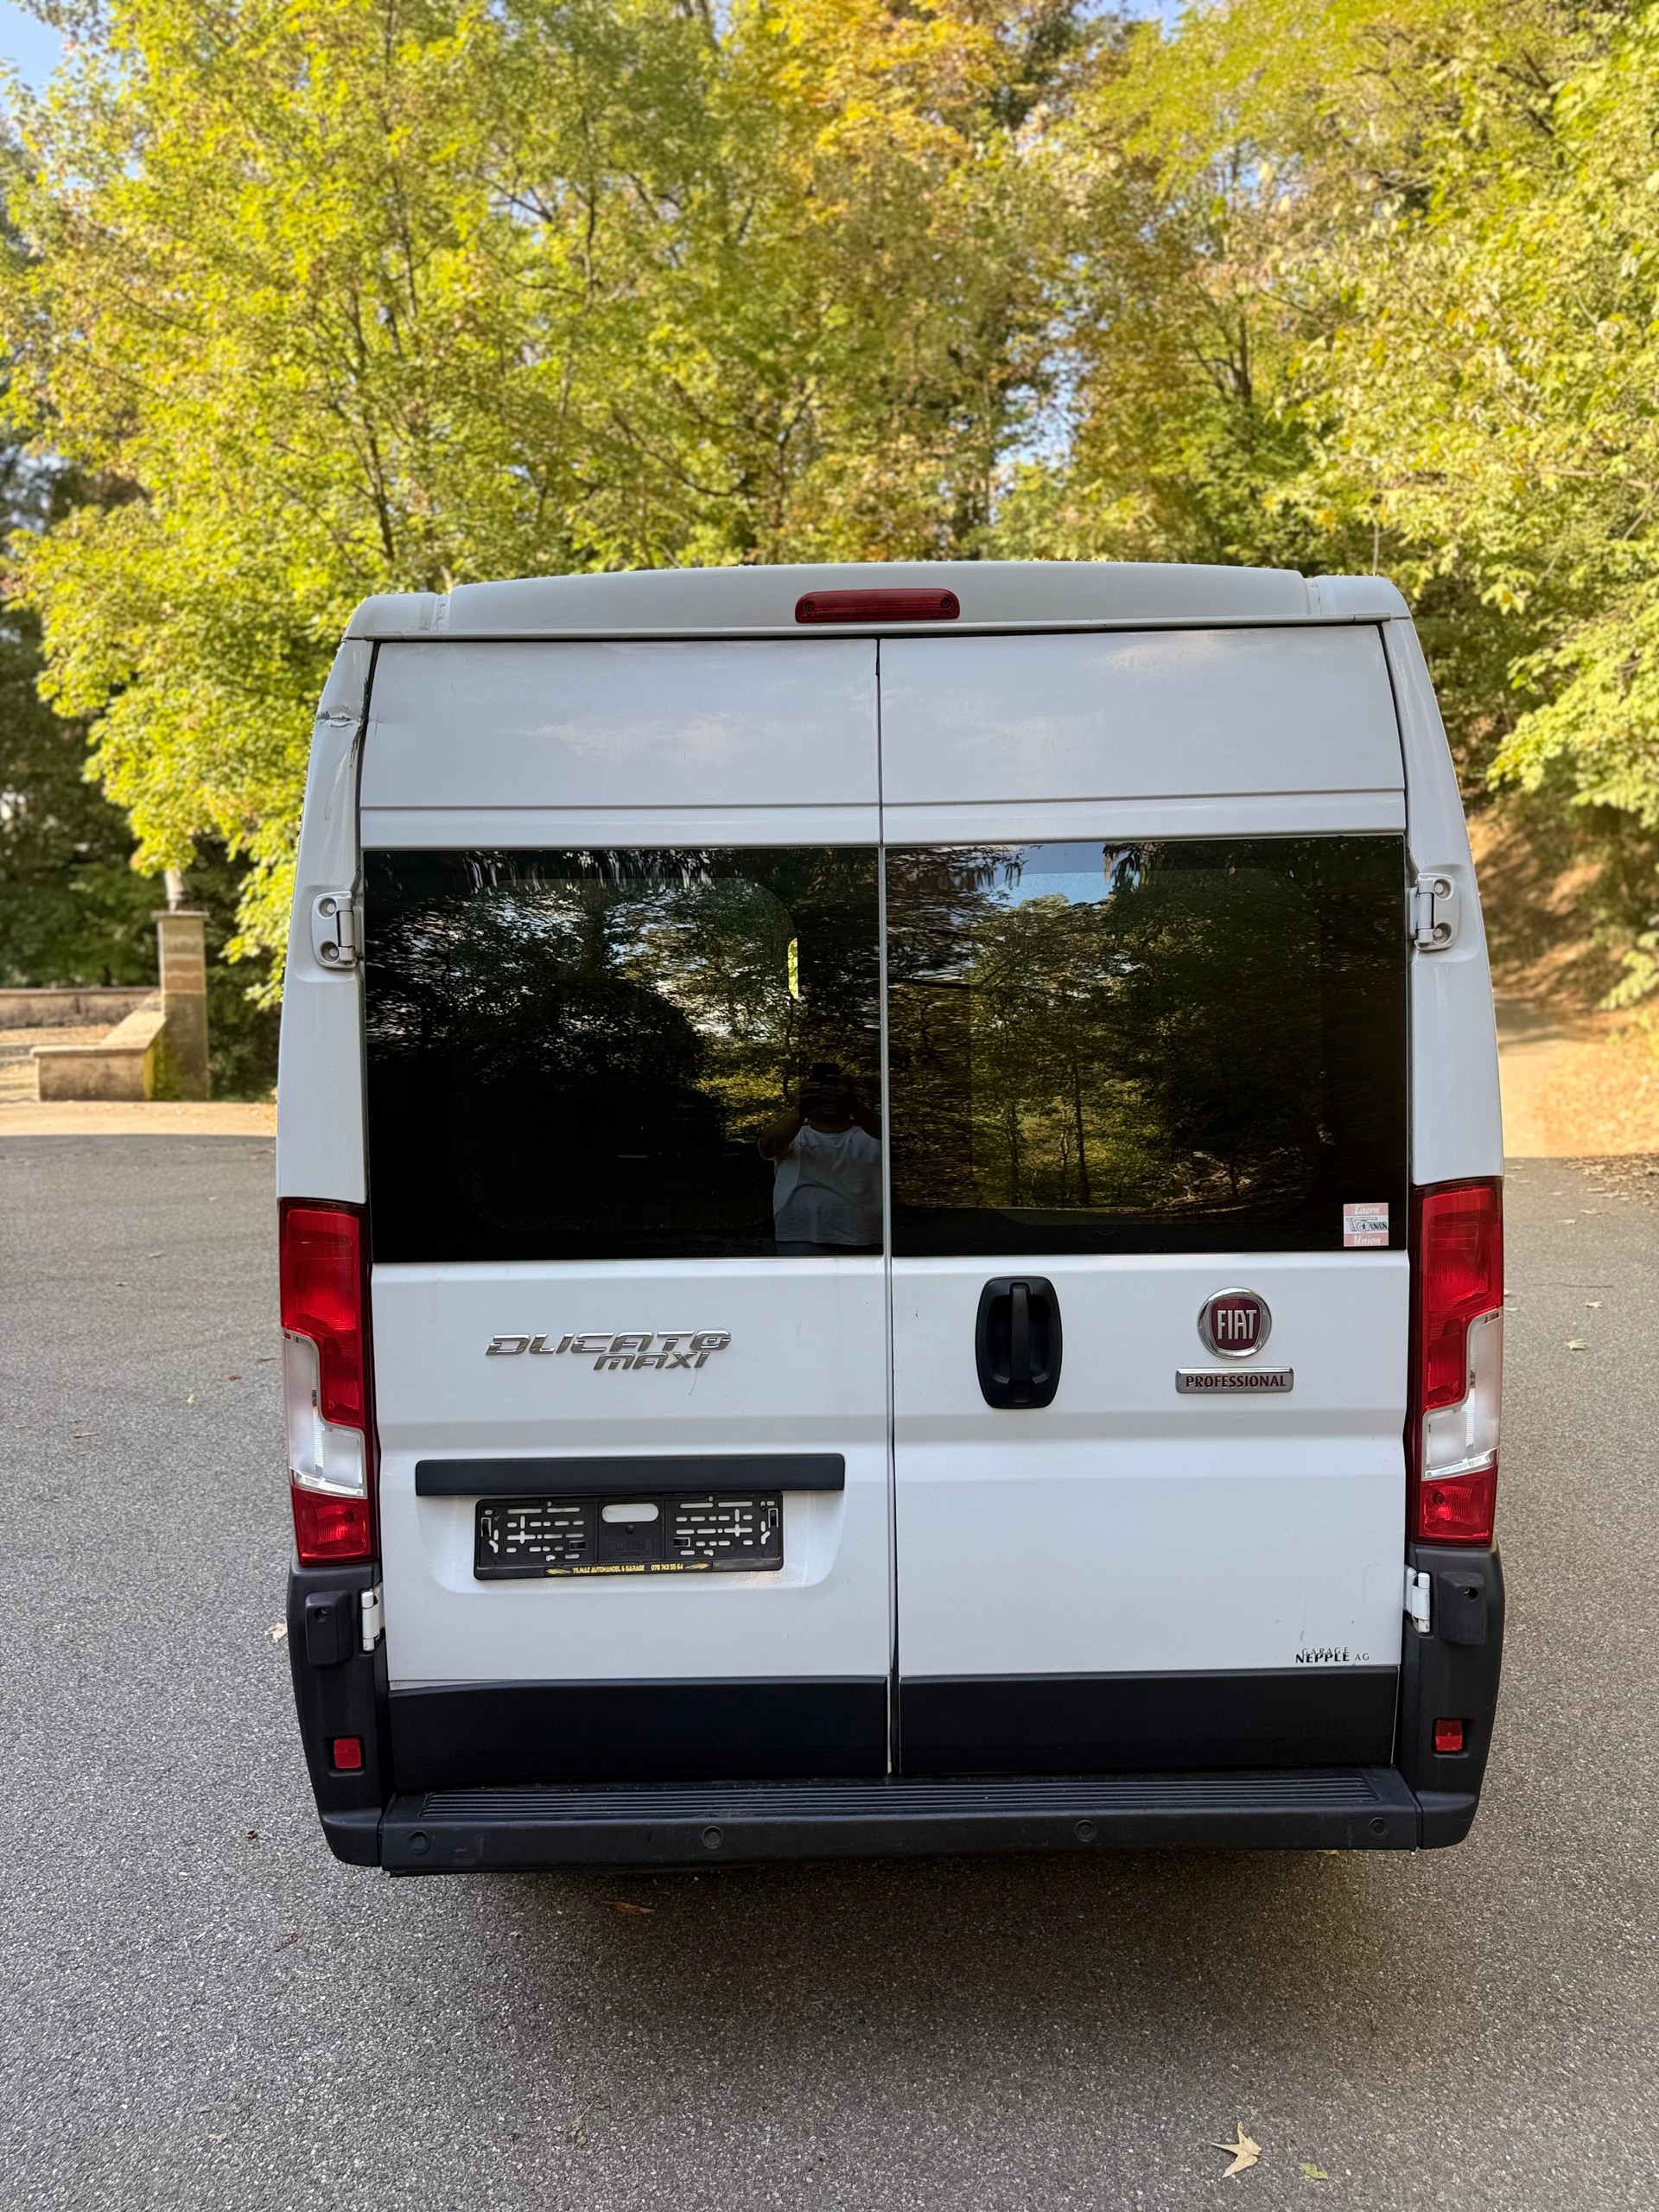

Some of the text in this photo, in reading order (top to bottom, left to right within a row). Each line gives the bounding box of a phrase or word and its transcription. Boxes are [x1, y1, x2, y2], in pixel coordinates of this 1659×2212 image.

[1353, 1235, 1381, 1245] Union
[1217, 1310, 1257, 1340] FIAT
[486, 1330, 732, 1356] DUCATO
[594, 1351, 710, 1370] MAXI
[1185, 1375, 1287, 1388] PROFESSIONAL
[1295, 1652, 1370, 1663] NEPPLE AG
[1301, 1647, 1350, 1656] GARAGE
